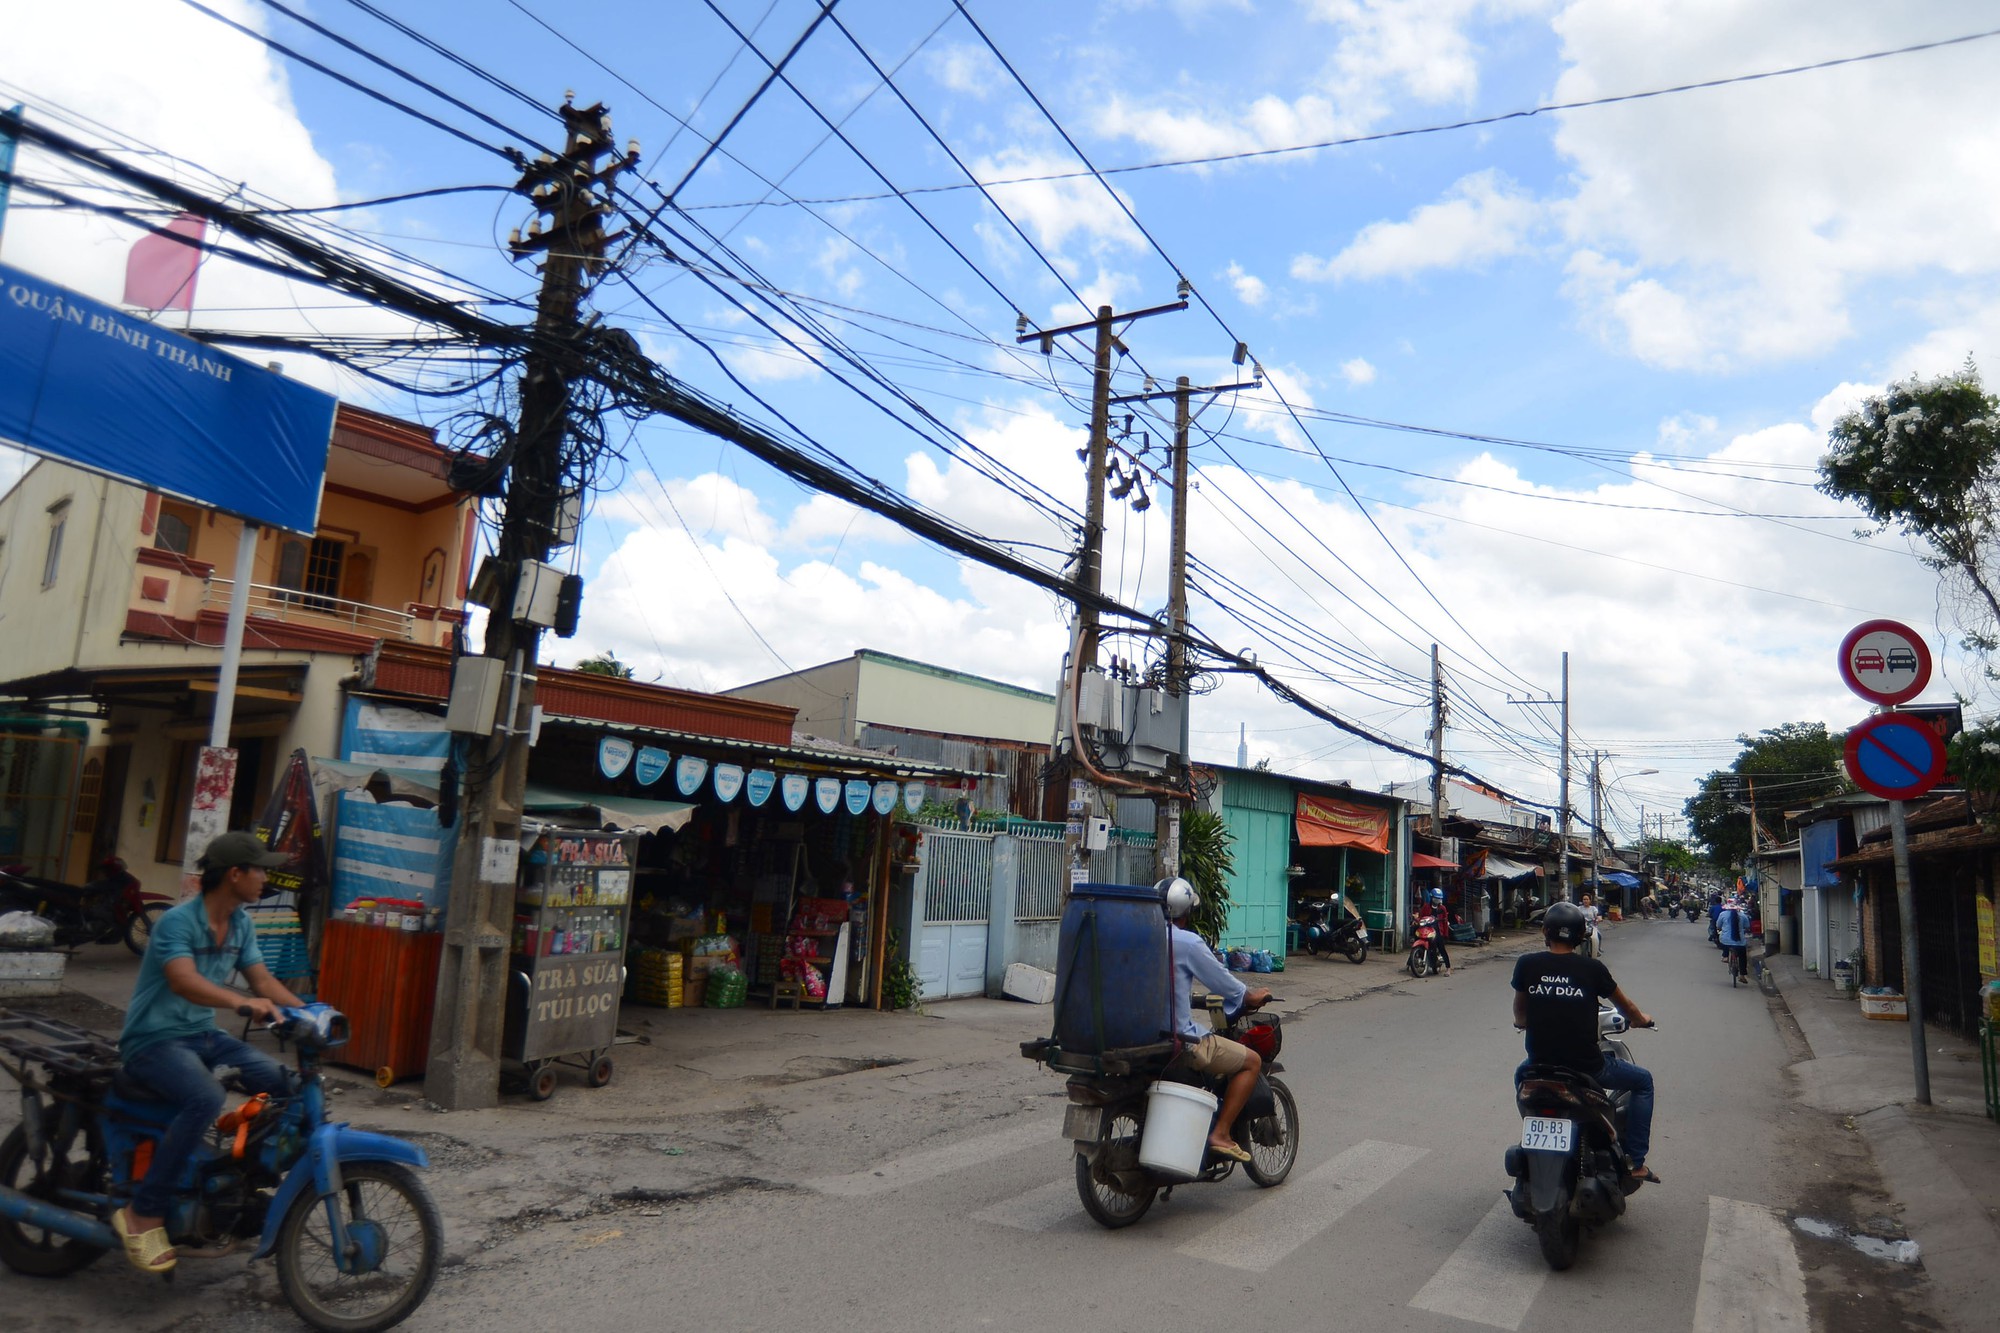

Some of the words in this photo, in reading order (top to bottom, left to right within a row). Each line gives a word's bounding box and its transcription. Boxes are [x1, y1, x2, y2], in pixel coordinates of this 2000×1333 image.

[9, 284, 86, 325] QUẬN
[89, 315, 150, 351] BÌNH
[155, 340, 232, 383] THẠNH
[560, 838, 590, 862] TRÀ
[538, 963, 577, 990] TRÀ
[582, 960, 619, 985] SỮA
[1528, 984, 1552, 995] CÂY
[538, 992, 573, 1021] TÚI
[576, 993, 612, 1018] LỌC
[1525, 1133, 1567, 1149] 377.15
